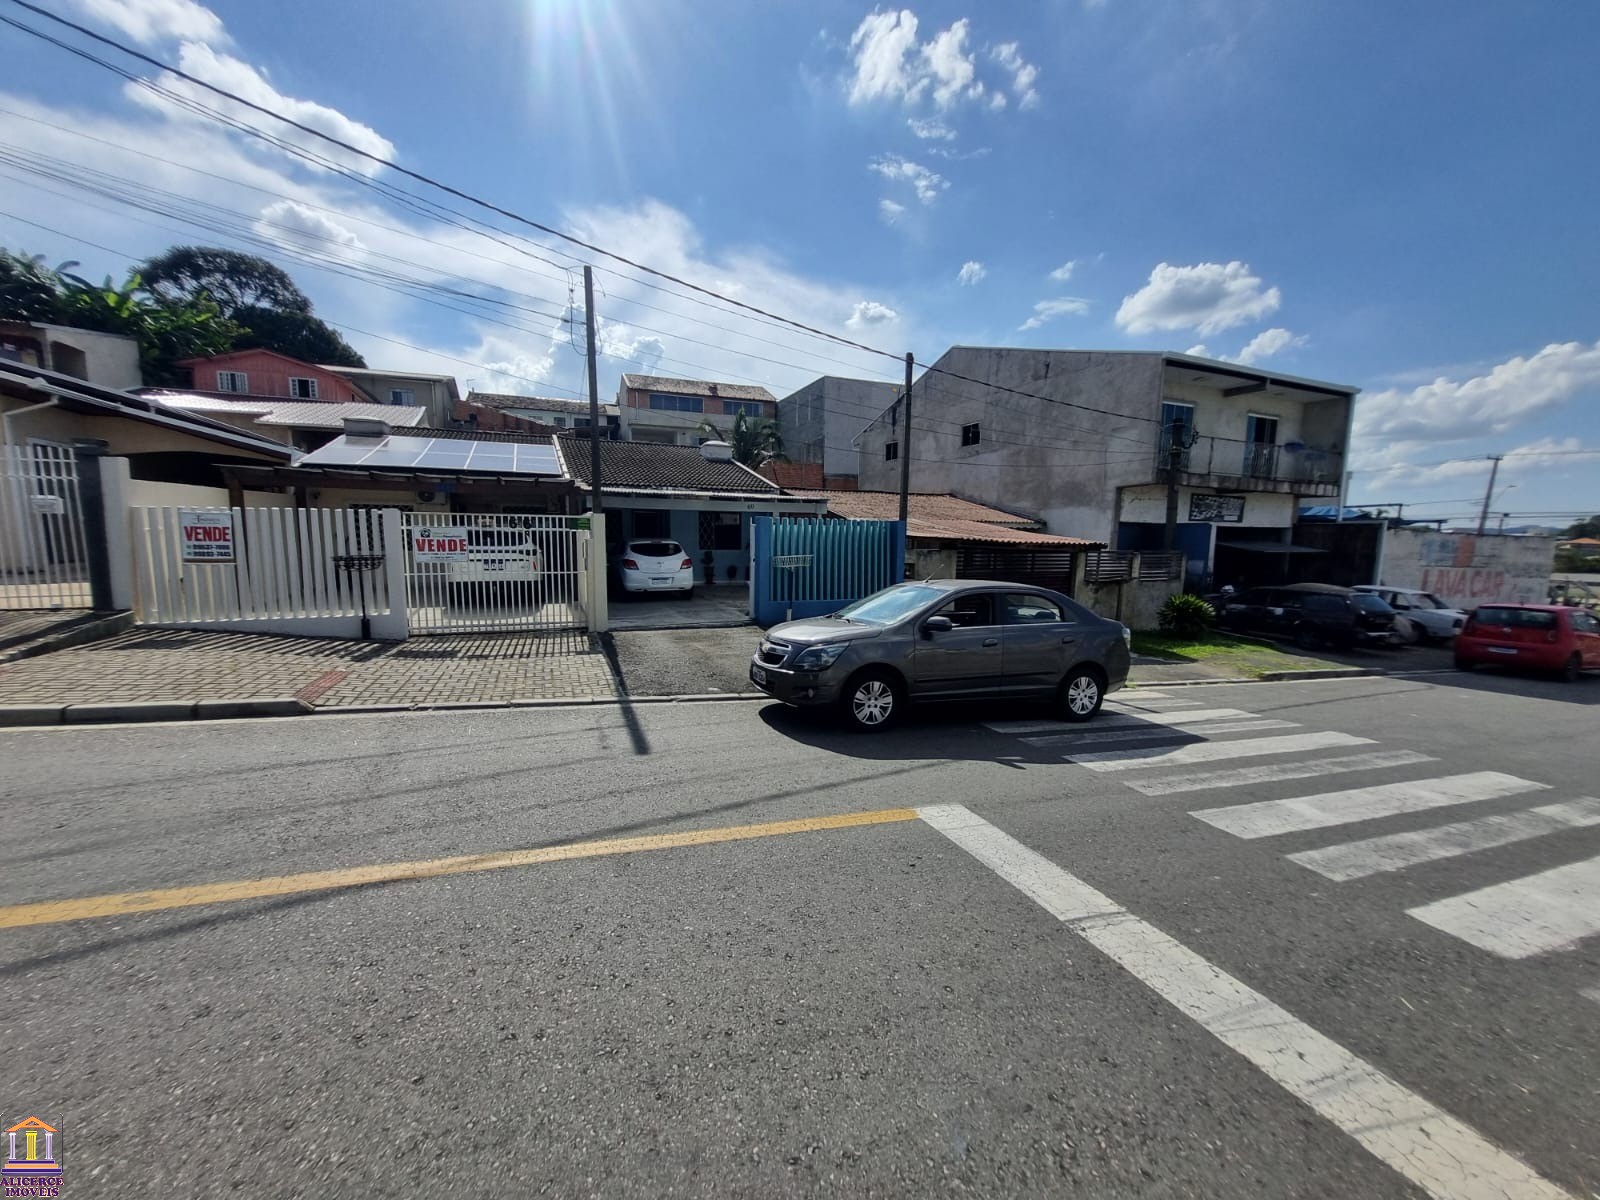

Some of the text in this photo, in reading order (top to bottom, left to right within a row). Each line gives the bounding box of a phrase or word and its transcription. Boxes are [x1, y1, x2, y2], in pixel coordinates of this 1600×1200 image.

[184, 526, 231, 542] VENDE
[416, 539, 467, 552] VENDE
[1421, 568, 1466, 597] LAVA
